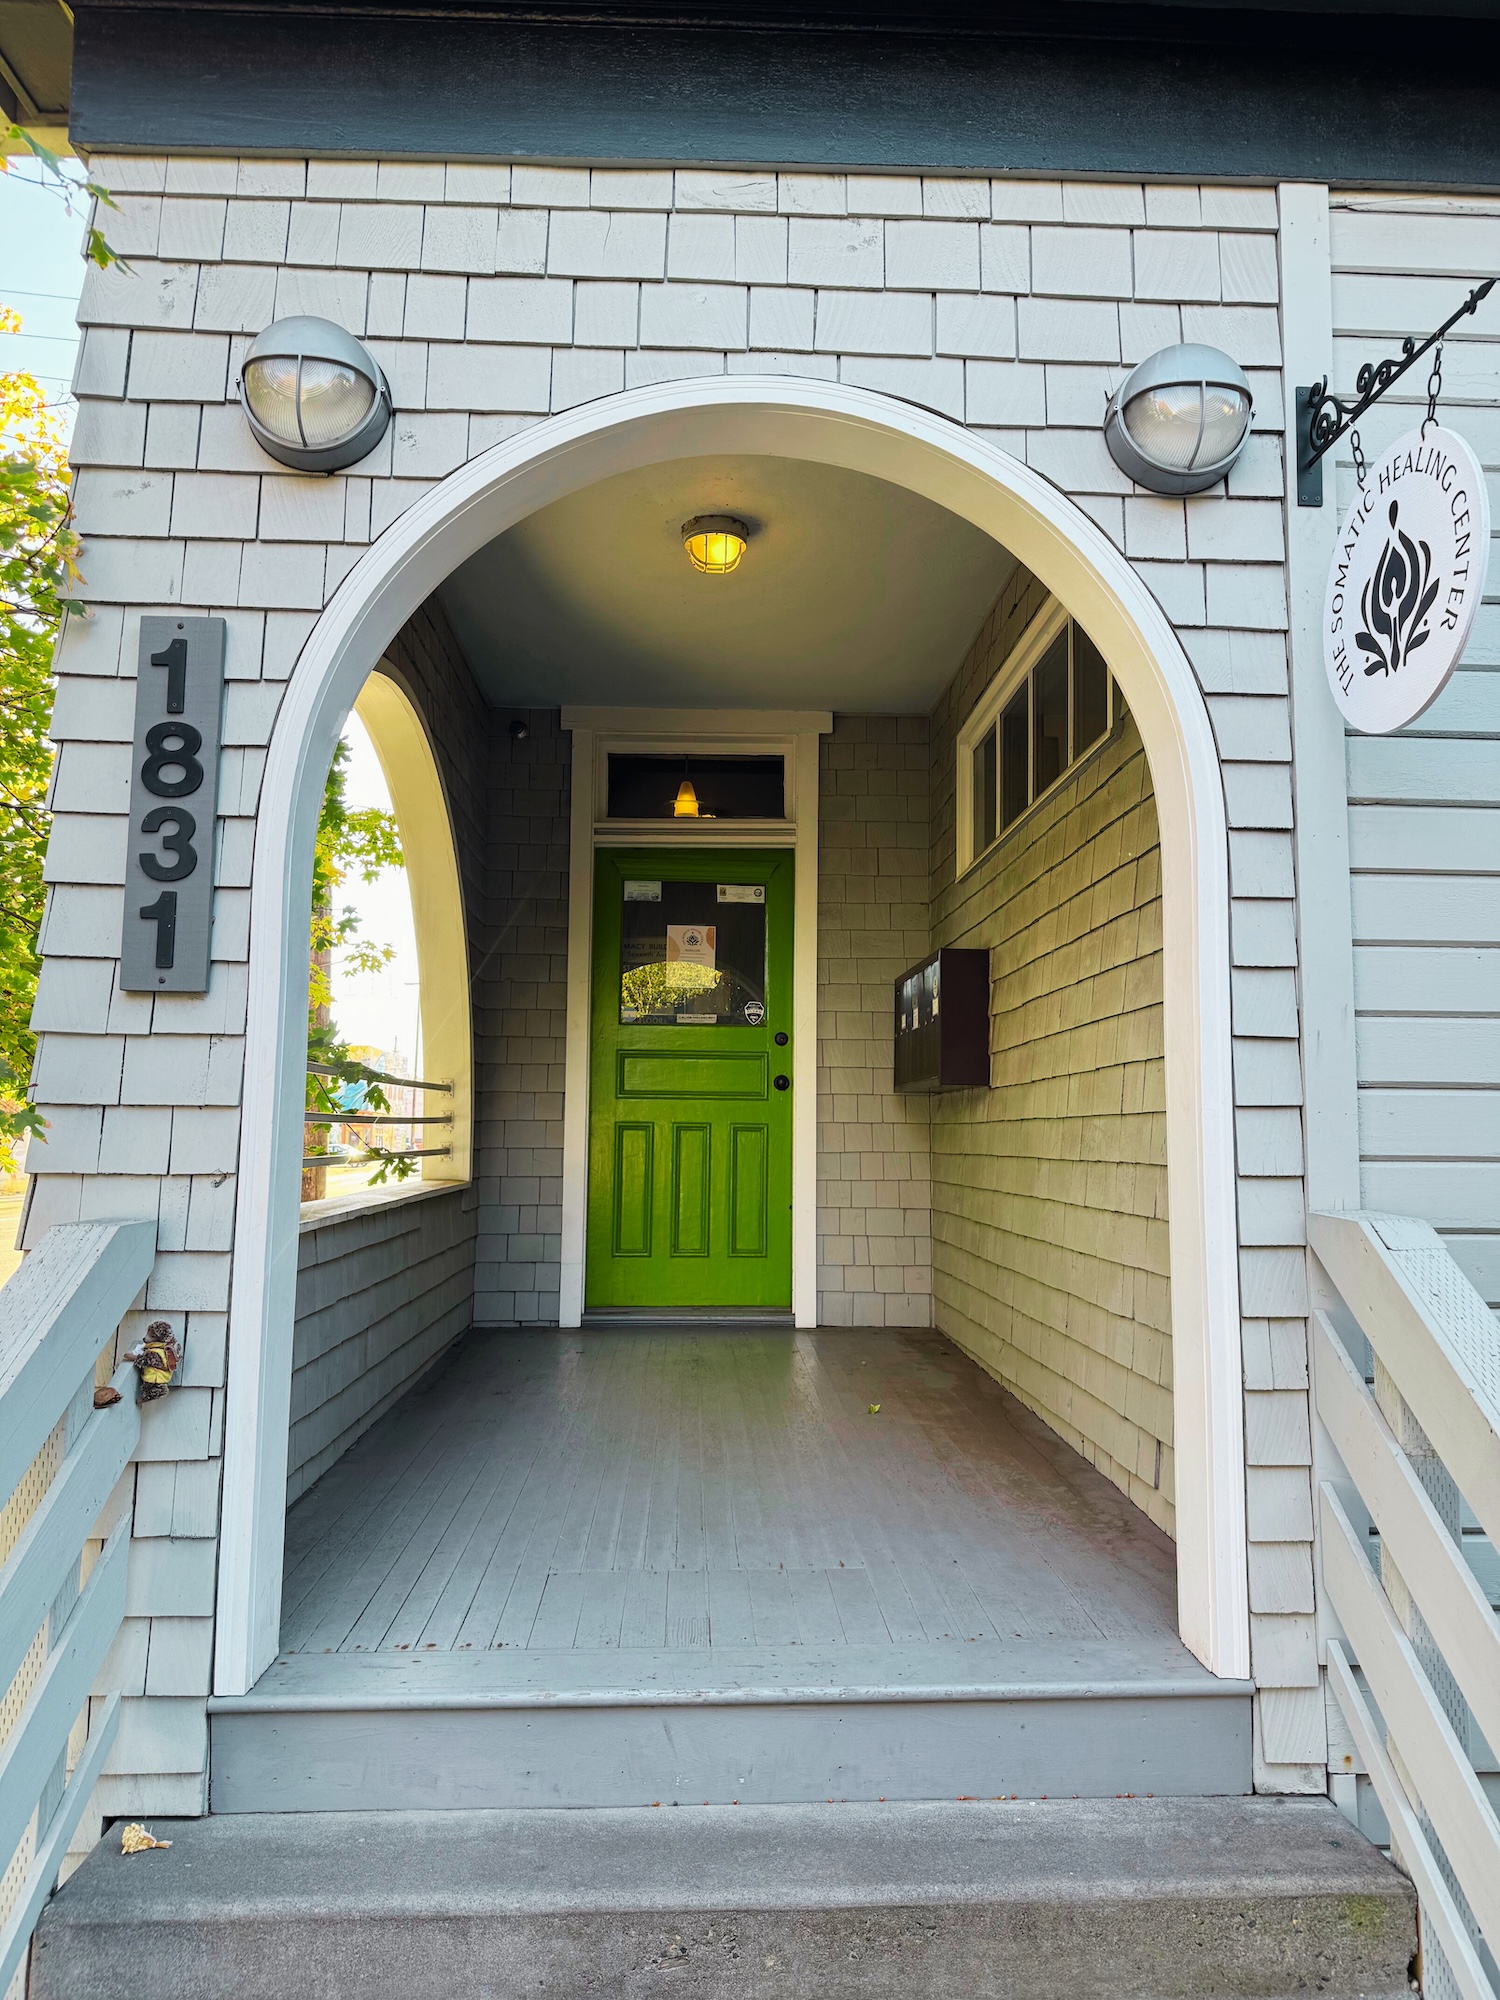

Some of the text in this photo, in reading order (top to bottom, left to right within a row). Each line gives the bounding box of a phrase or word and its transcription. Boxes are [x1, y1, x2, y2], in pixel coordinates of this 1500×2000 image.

[1330, 446, 1471, 697] THE SOMATIC HEALING CENTER
[139, 638, 204, 968] 1831
